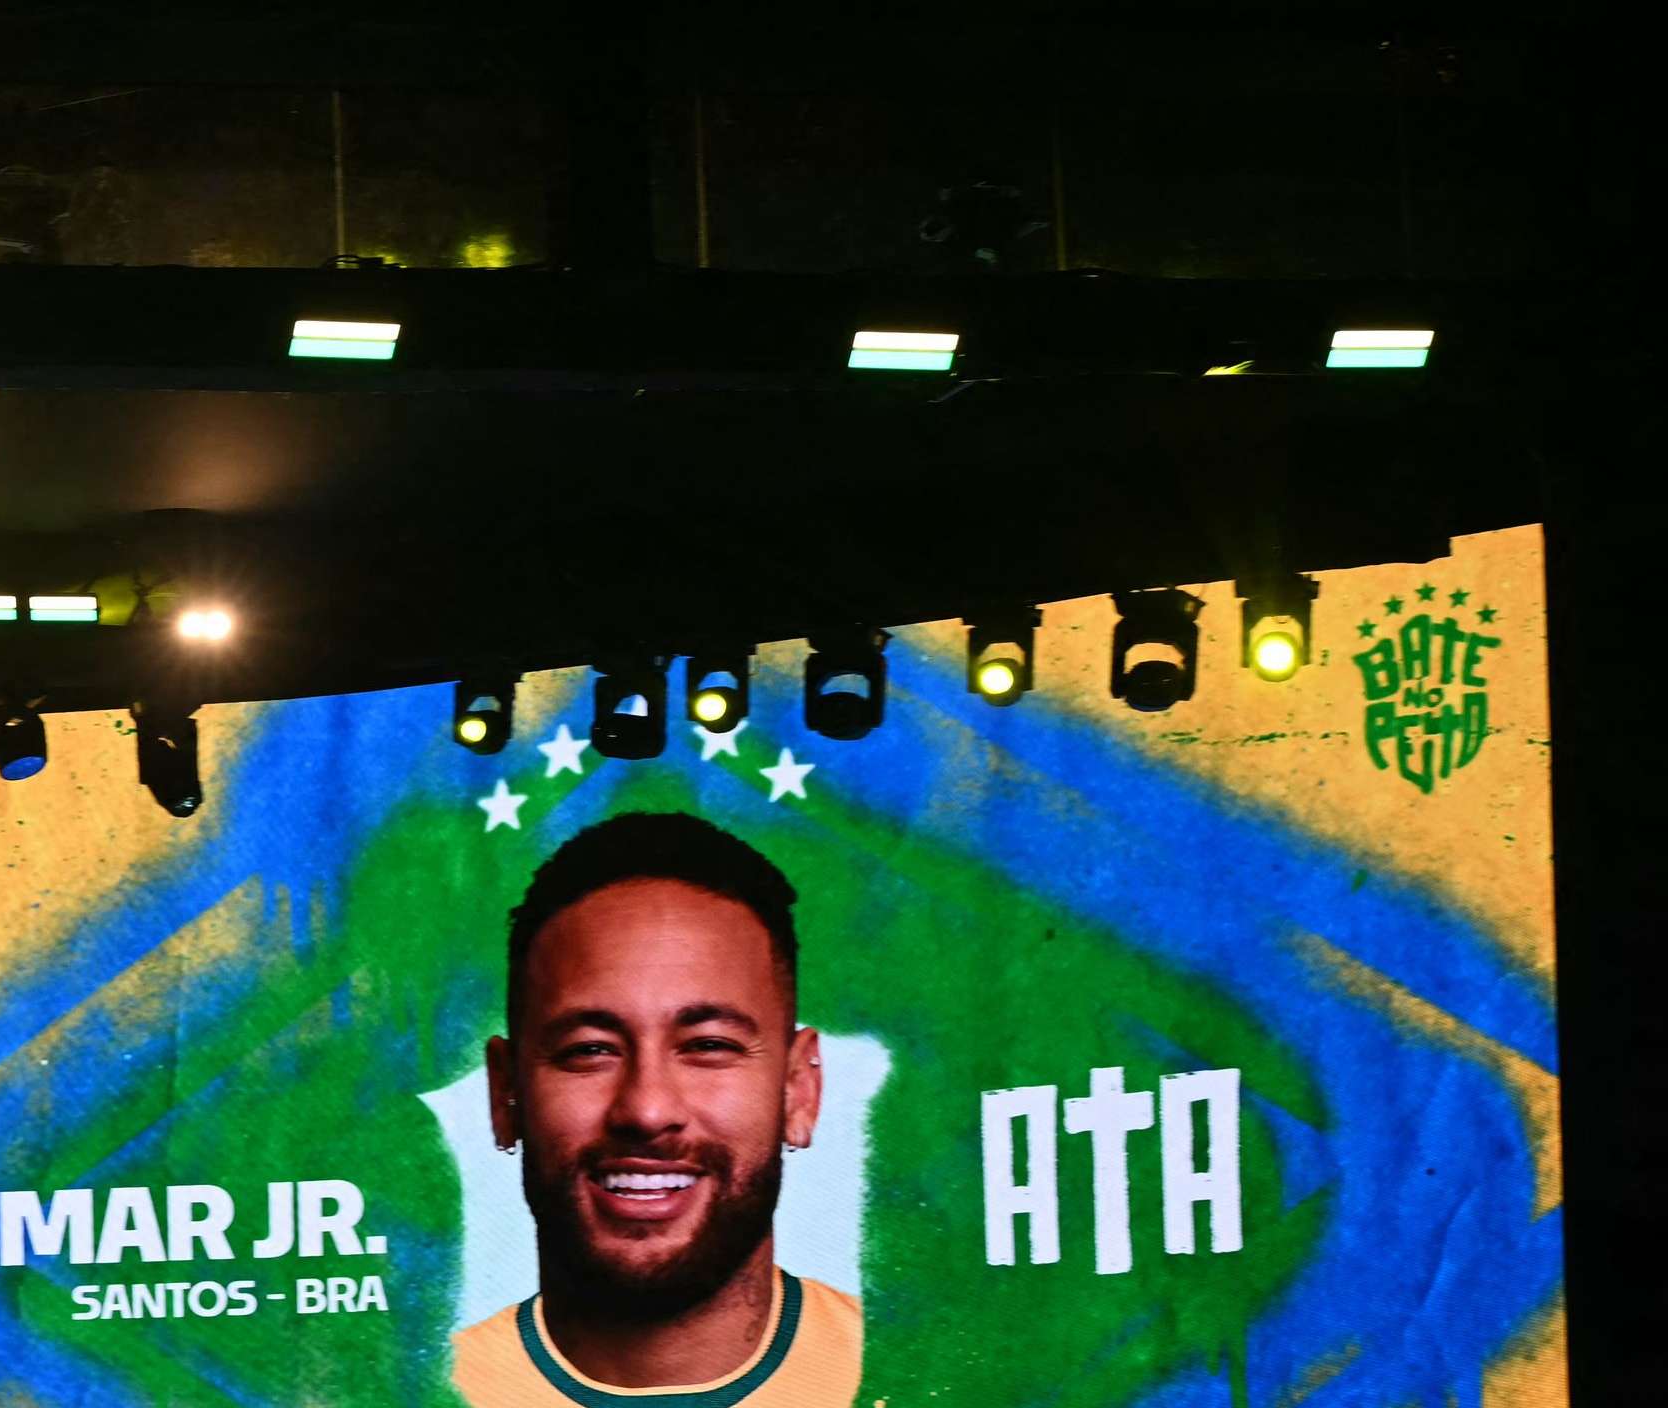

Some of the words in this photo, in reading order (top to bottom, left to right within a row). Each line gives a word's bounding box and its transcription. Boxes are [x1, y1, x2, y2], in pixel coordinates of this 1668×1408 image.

[1352, 614, 1502, 701] BATE
[1403, 681, 1444, 708] NO
[982, 1066, 1242, 1275] ATA
[253, 1179, 387, 1259] JR.
[71, 1280, 258, 1321] SANTOS
[296, 1275, 389, 1314] BRA
